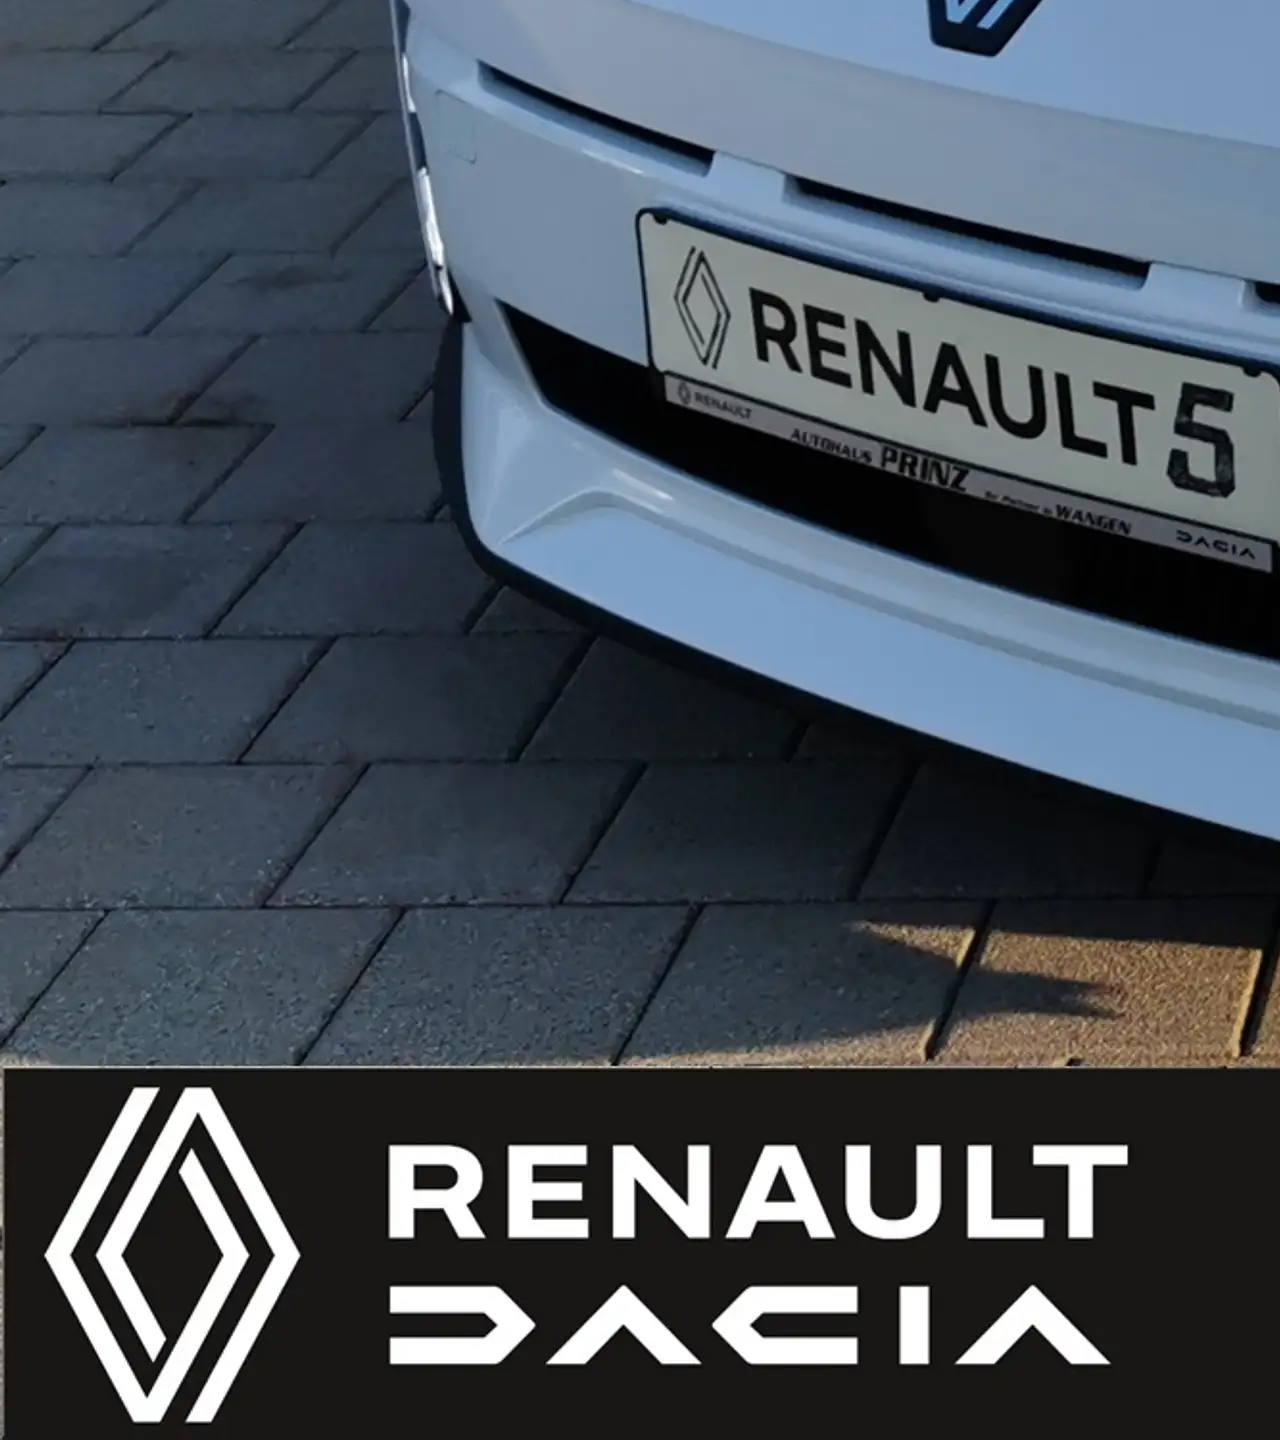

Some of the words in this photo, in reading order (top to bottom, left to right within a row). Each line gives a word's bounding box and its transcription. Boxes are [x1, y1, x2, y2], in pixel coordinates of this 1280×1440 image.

[694, 391, 752, 419] RENAULT
[749, 287, 1154, 466] RENAULT
[791, 428, 873, 464] AUTOHAUS
[880, 445, 970, 492] PRINZ
[1055, 503, 1132, 536] WANGEN
[1175, 529, 1256, 560] DACIA
